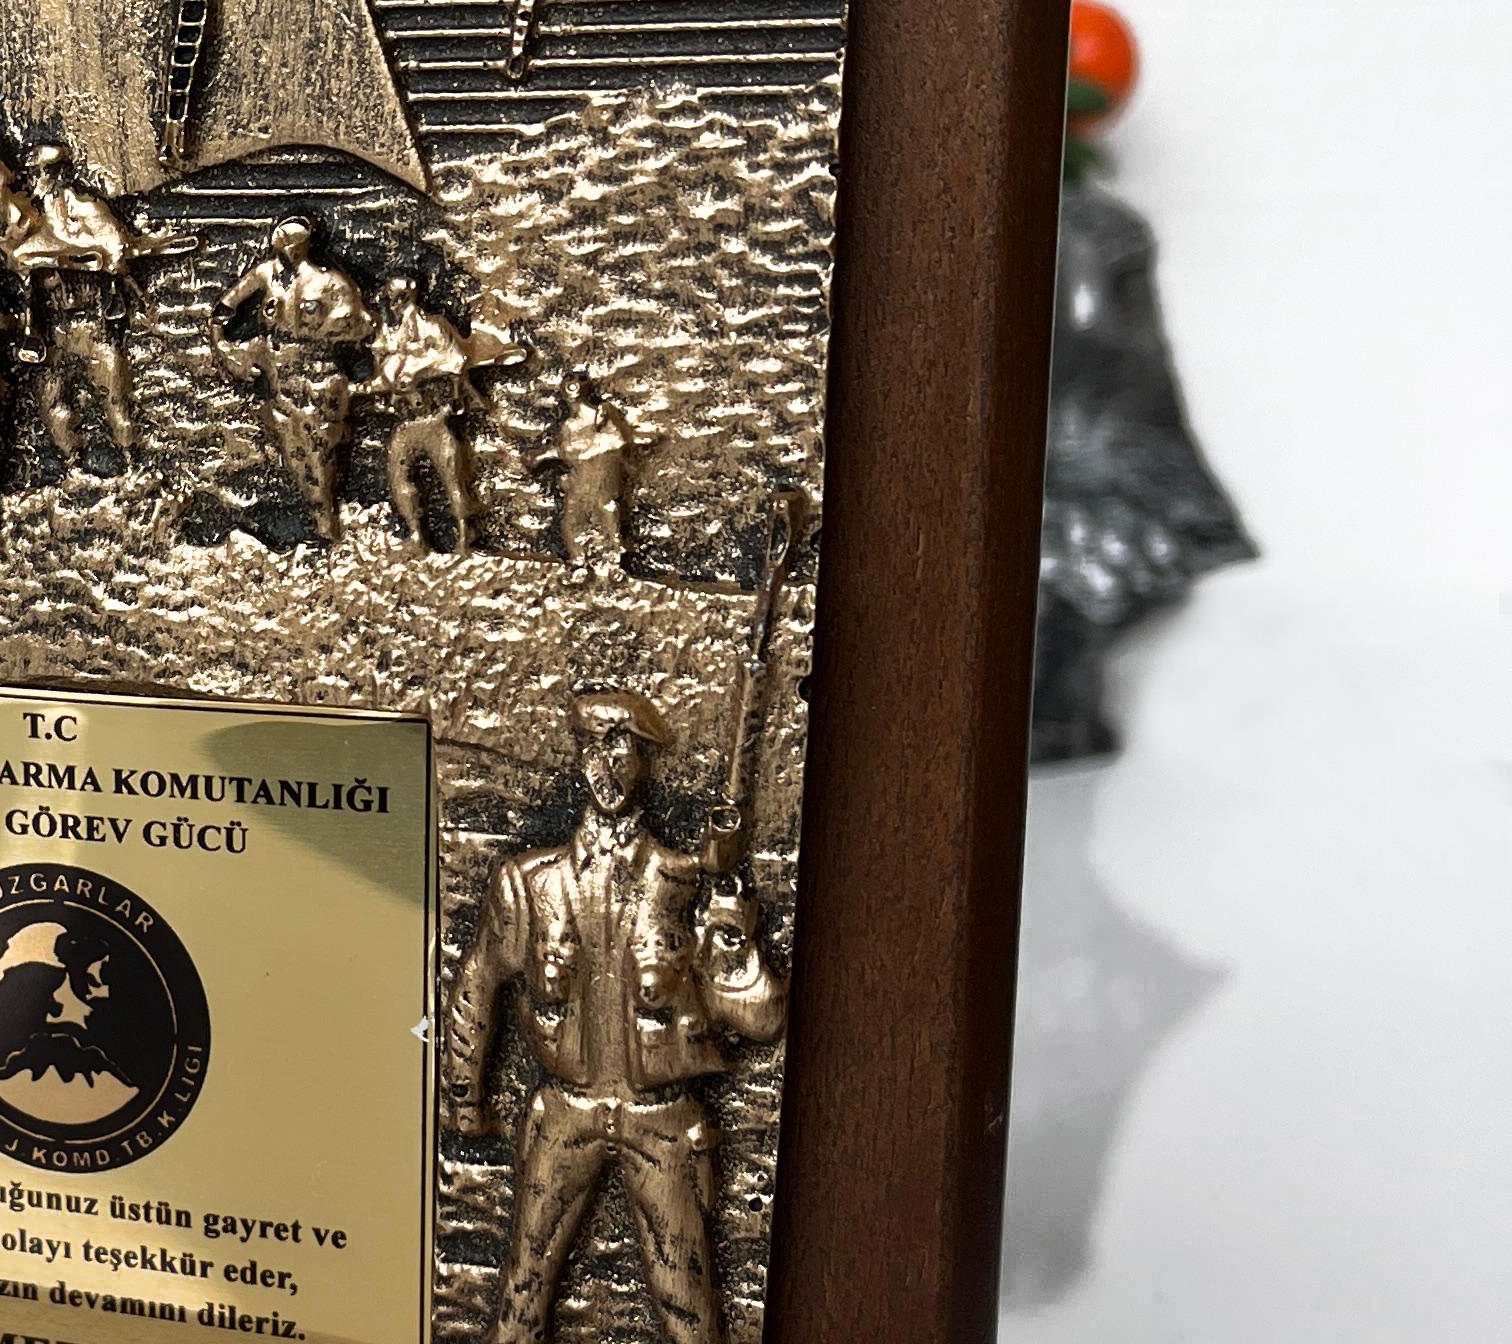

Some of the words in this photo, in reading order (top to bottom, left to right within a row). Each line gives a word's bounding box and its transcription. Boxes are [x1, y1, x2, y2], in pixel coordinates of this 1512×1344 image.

[23, 712, 77, 742] T.C
[112, 768, 389, 813] KOMUTANLIĞI
[5, 805, 133, 843] GÖREV
[143, 816, 248, 853] GÜCÜ
[110, 1195, 192, 1228] üstün
[203, 1213, 302, 1243] gayret
[312, 1227, 347, 1249] ve
[82, 1240, 214, 1278] teşekkür
[224, 1260, 298, 1296] eder,
[48, 1281, 187, 1323] devamını
[197, 1302, 306, 1341] dileriz.
